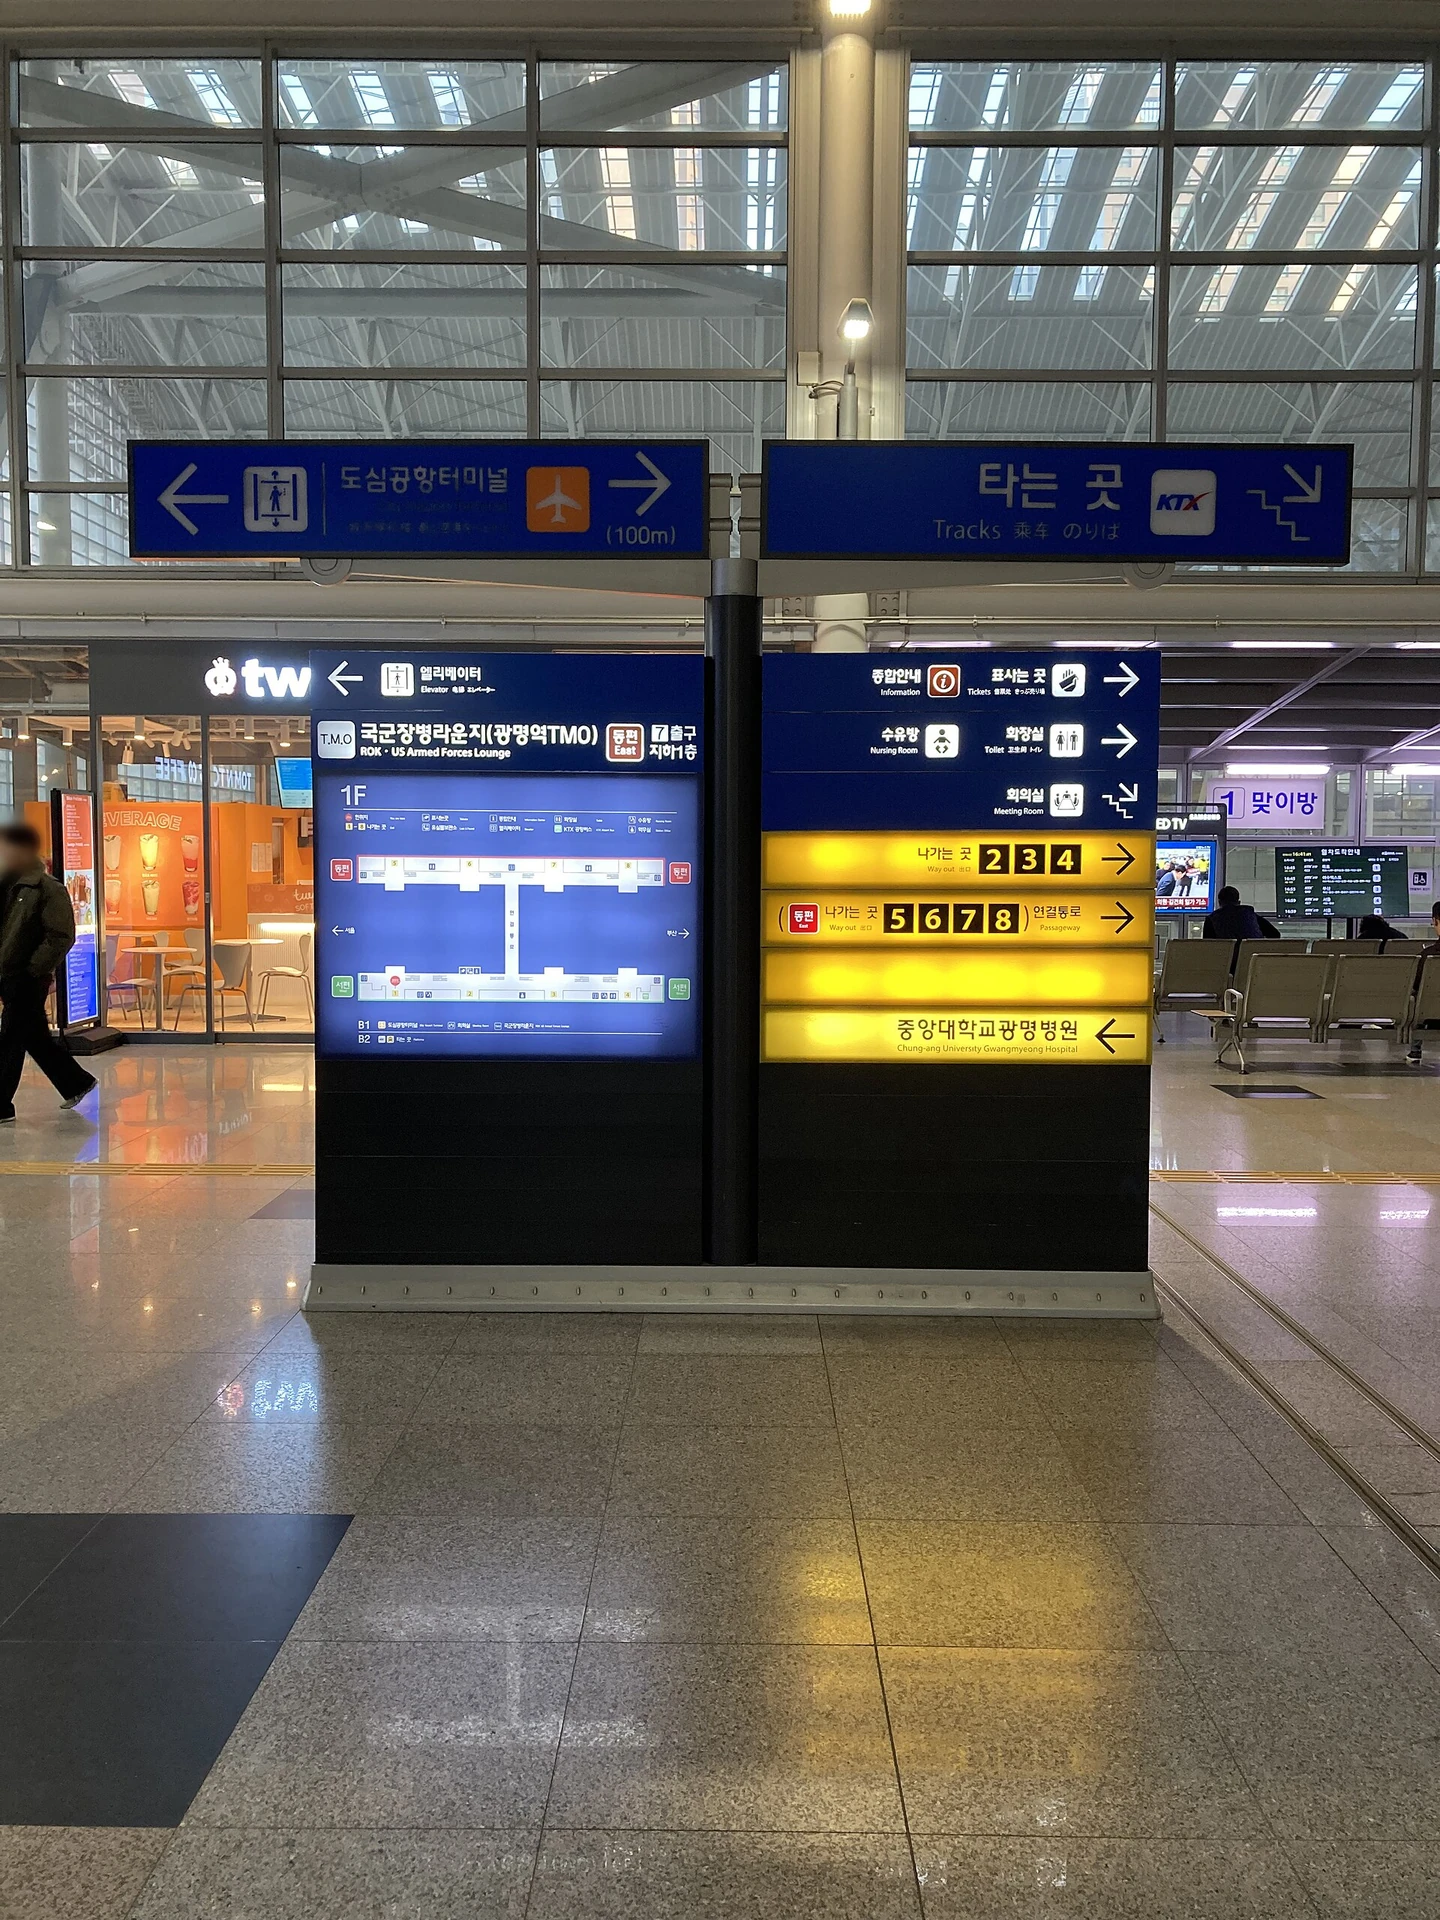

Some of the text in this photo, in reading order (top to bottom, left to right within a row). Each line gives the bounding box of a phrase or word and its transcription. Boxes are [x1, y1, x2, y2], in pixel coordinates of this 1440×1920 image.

[340, 465, 509, 494] 도심공항터미널
[978, 462, 1124, 511] 타는 곳
[1156, 491, 1212, 511] KTX
[606, 524, 676, 546] (100m)
[932, 518, 1121, 541] Tracks 乘车 のりば
[419, 665, 482, 682] 엘리베이터
[872, 669, 921, 684] 종합안내
[991, 668, 1046, 684] 표사는 곳
[420, 686, 449, 694] Elevator
[880, 688, 921, 696] Information
[967, 688, 991, 696] Tickets
[320, 733, 353, 747] T.M.O
[360, 722, 598, 746] 국군장병라운지(광명역TMO)
[611, 730, 638, 743] 동편
[655, 726, 697, 741] 7 출구
[882, 727, 920, 742] 수유방
[1006, 726, 1044, 742] 화장실
[360, 747, 511, 760] ROK US Armed Forces Lounge
[614, 745, 637, 756] East
[649, 744, 697, 760] 지하1층
[870, 747, 918, 756] Nursing Room
[340, 785, 366, 806] 1F
[1006, 787, 1044, 803] 회의실
[1221, 791, 1318, 816] 1 맞이방
[994, 807, 1044, 816] Meeting Room
[104, 811, 182, 831] VERAGE
[1172, 818, 1187, 830] TV
[918, 847, 972, 861] 나가는 곳
[986, 849, 1003, 870] 2
[1022, 849, 1037, 870] 3
[1057, 849, 1074, 870] 4
[928, 866, 942, 874] Way
[794, 910, 813, 922] 동편
[825, 905, 878, 919] 나가는 곳
[1033, 905, 1081, 918] 연결통로
[890, 909, 904, 930] 5
[926, 909, 940, 930] 6
[961, 909, 976, 930] 7
[995, 909, 1012, 930] 8
[829, 924, 844, 932] Way
[1040, 924, 1080, 932] Passageway
[358, 1021, 370, 1030] B1
[897, 1019, 1078, 1041] 중앙대학교광명병원
[358, 1034, 370, 1044] B2
[897, 1044, 1078, 1054] Chung-ang University Gwangmyeong Hospital
